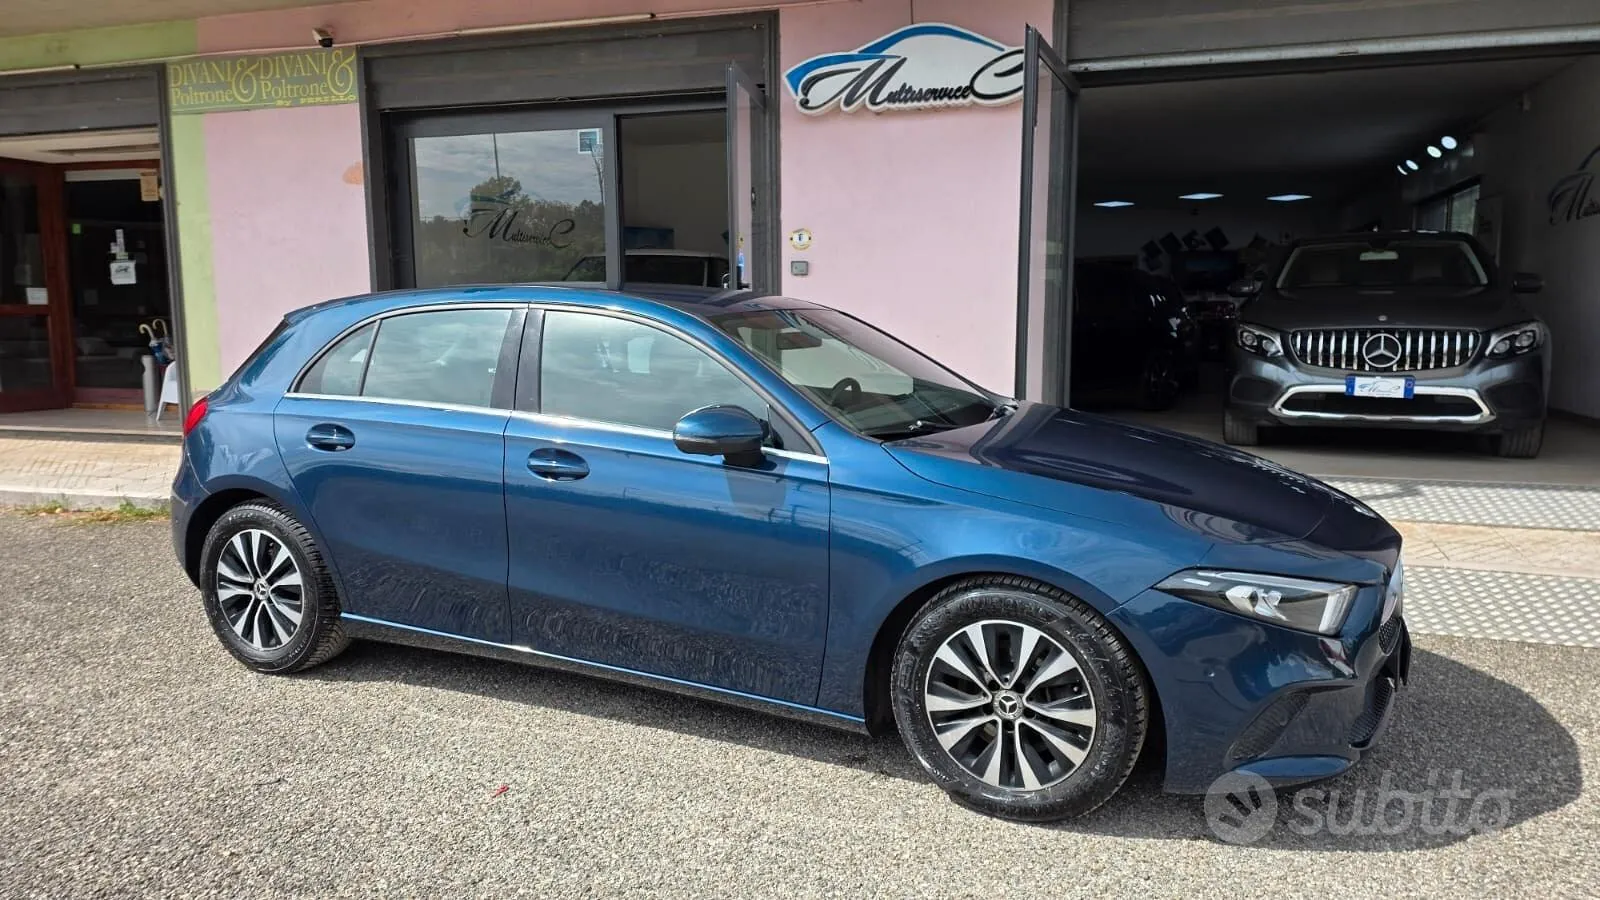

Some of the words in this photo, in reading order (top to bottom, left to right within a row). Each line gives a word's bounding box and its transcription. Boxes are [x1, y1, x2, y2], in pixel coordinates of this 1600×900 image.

[171, 60, 232, 88] DIVANI
[260, 52, 327, 80] DIVANI
[172, 87, 233, 106] Poltrone
[260, 80, 328, 100] Poltrone
